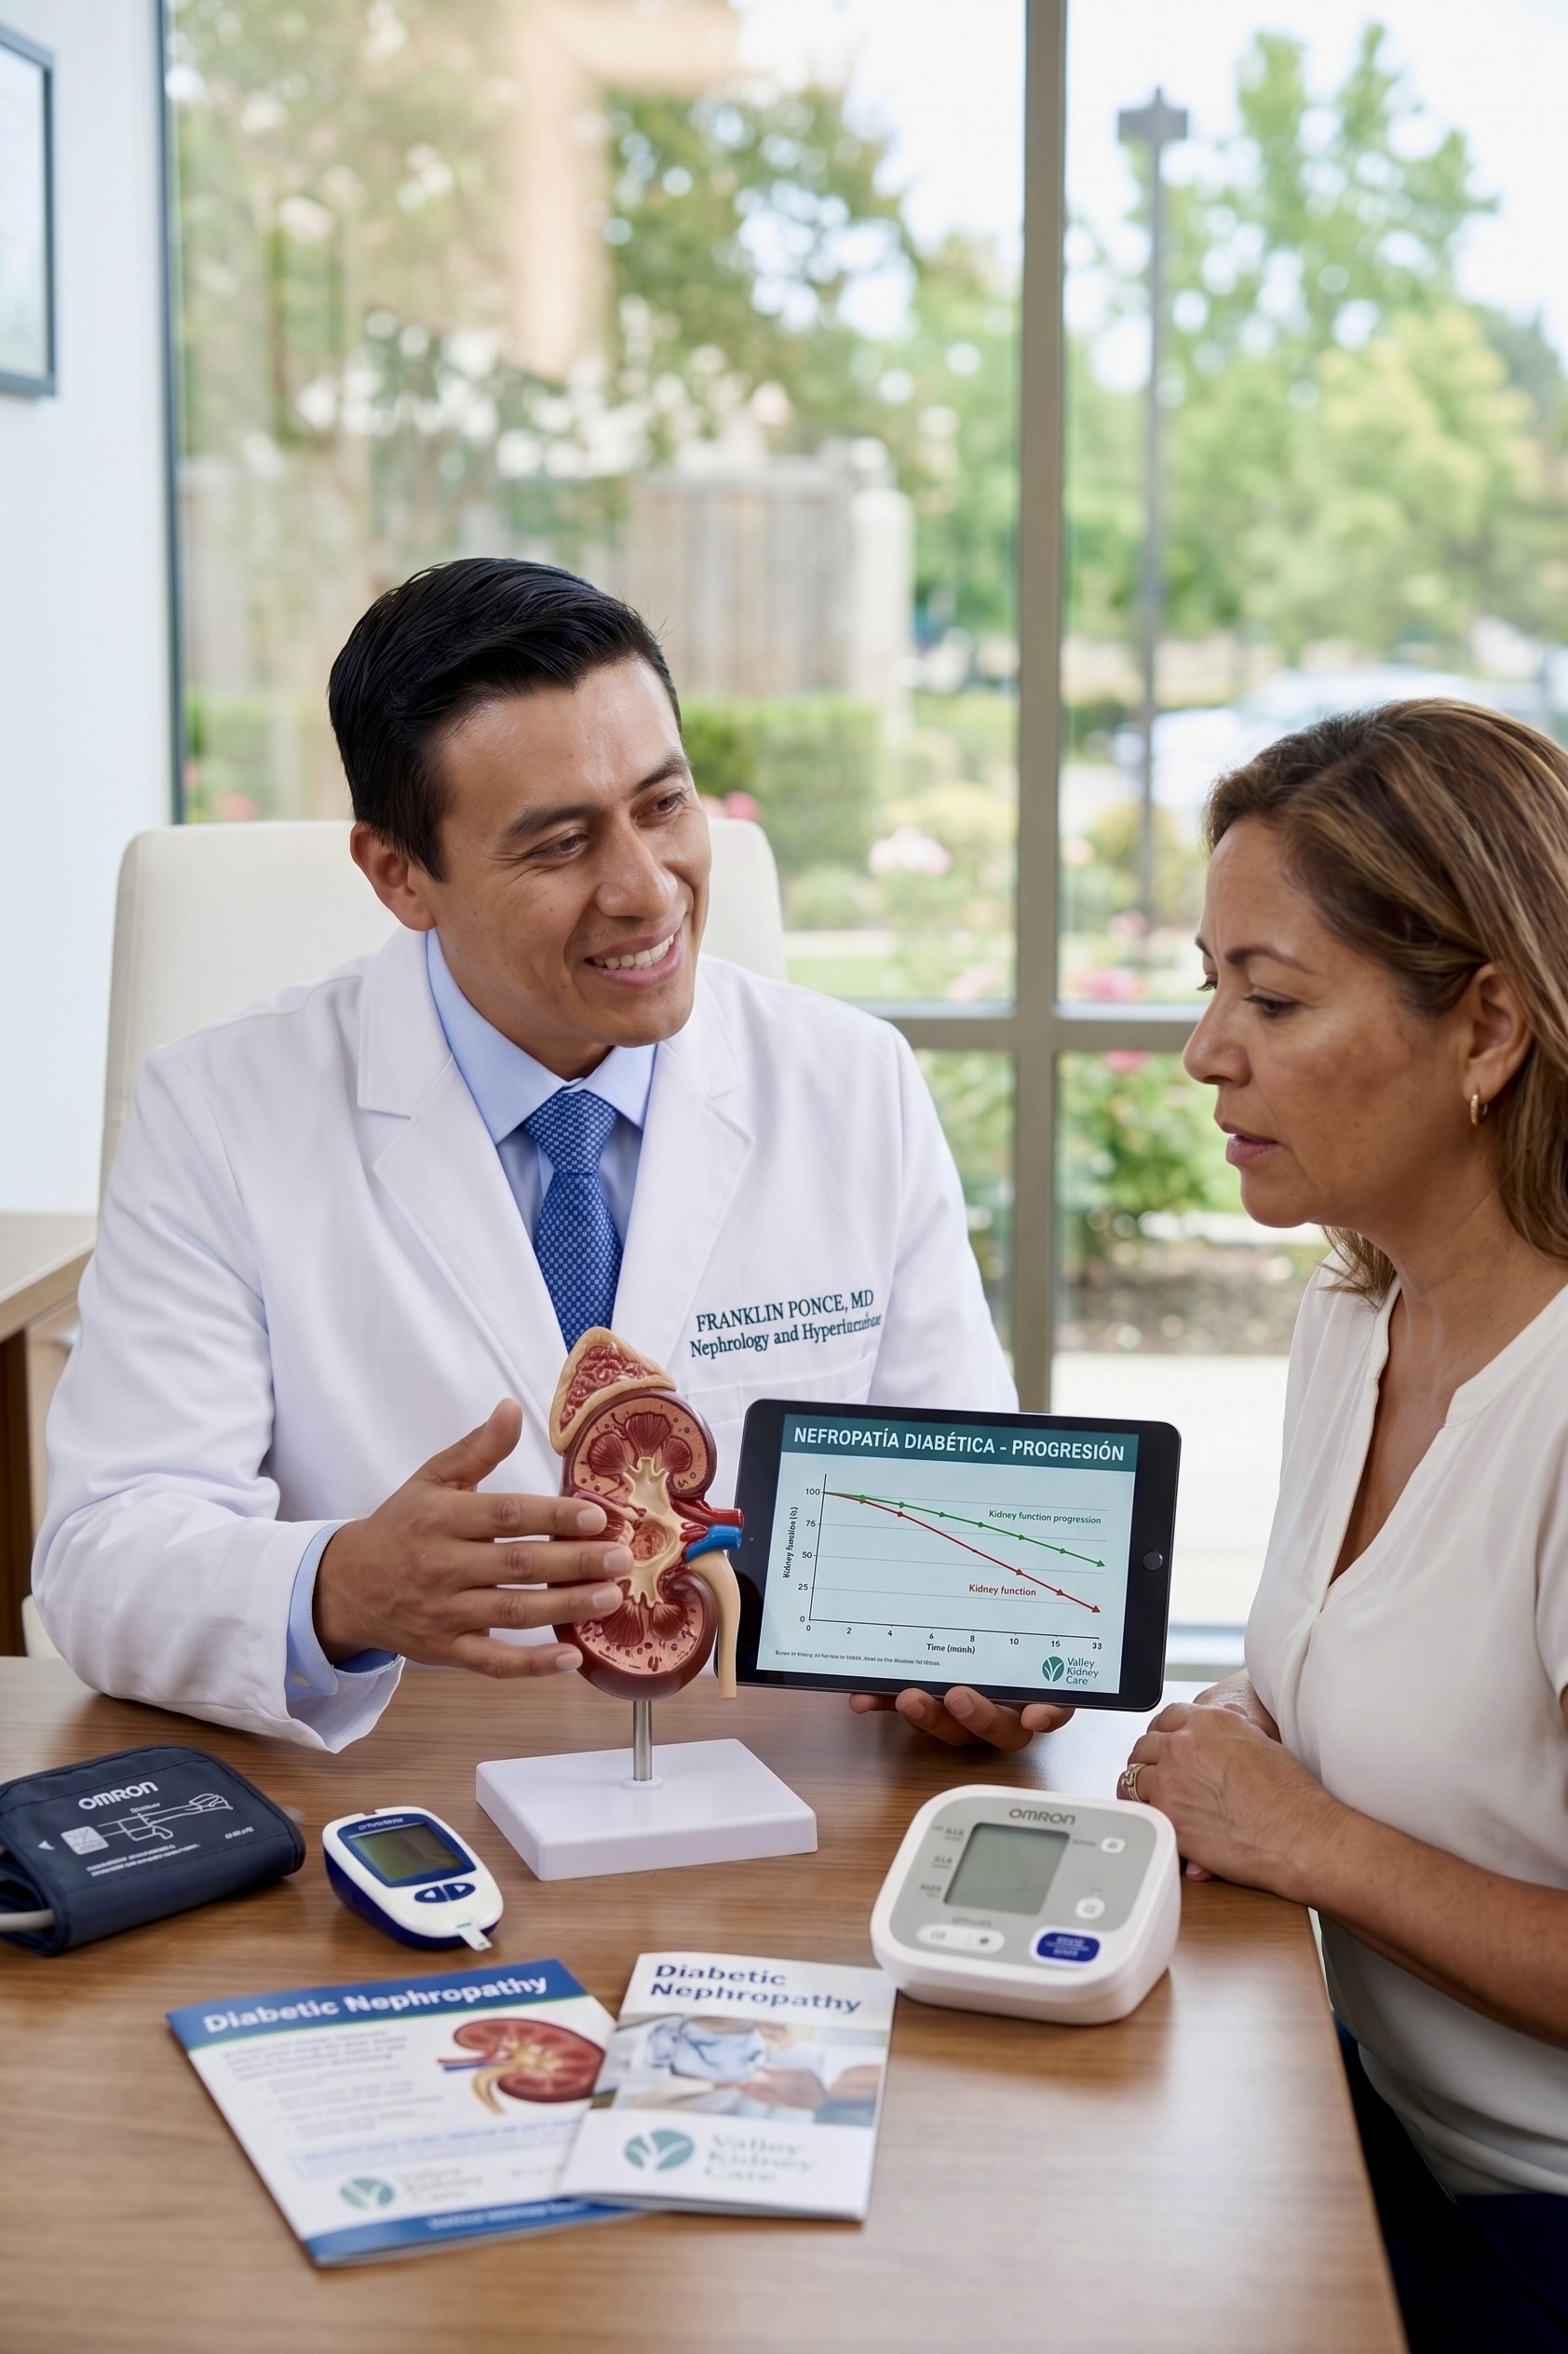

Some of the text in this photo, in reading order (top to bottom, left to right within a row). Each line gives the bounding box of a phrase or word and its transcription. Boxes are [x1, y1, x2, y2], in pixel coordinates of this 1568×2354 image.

[696, 1289, 874, 1333] FRANKLIN PONCE, MD
[690, 1329, 770, 1360] Nephrology
[774, 1324, 799, 1345] and
[793, 1427, 899, 1449] NEFROPATÍA
[903, 1431, 995, 1454] DIABÉTICA
[1011, 1440, 1125, 1462] PROGRESIÓN
[989, 1508, 1102, 1525] Kidney function progression
[968, 1583, 1036, 1597] Kidney function
[926, 1644, 946, 1653] Time
[1066, 1667, 1100, 1679] Kidney
[1067, 1657, 1095, 1669] Valley
[1066, 1676, 1088, 1685] Care
[78, 1780, 159, 1810] OMRON
[1008, 1807, 1076, 1826] OMRON
[654, 1962, 788, 1987] Diabetic
[203, 1974, 548, 2034] Diabetic Nephropathy
[650, 1981, 863, 2014] Nephropathy
